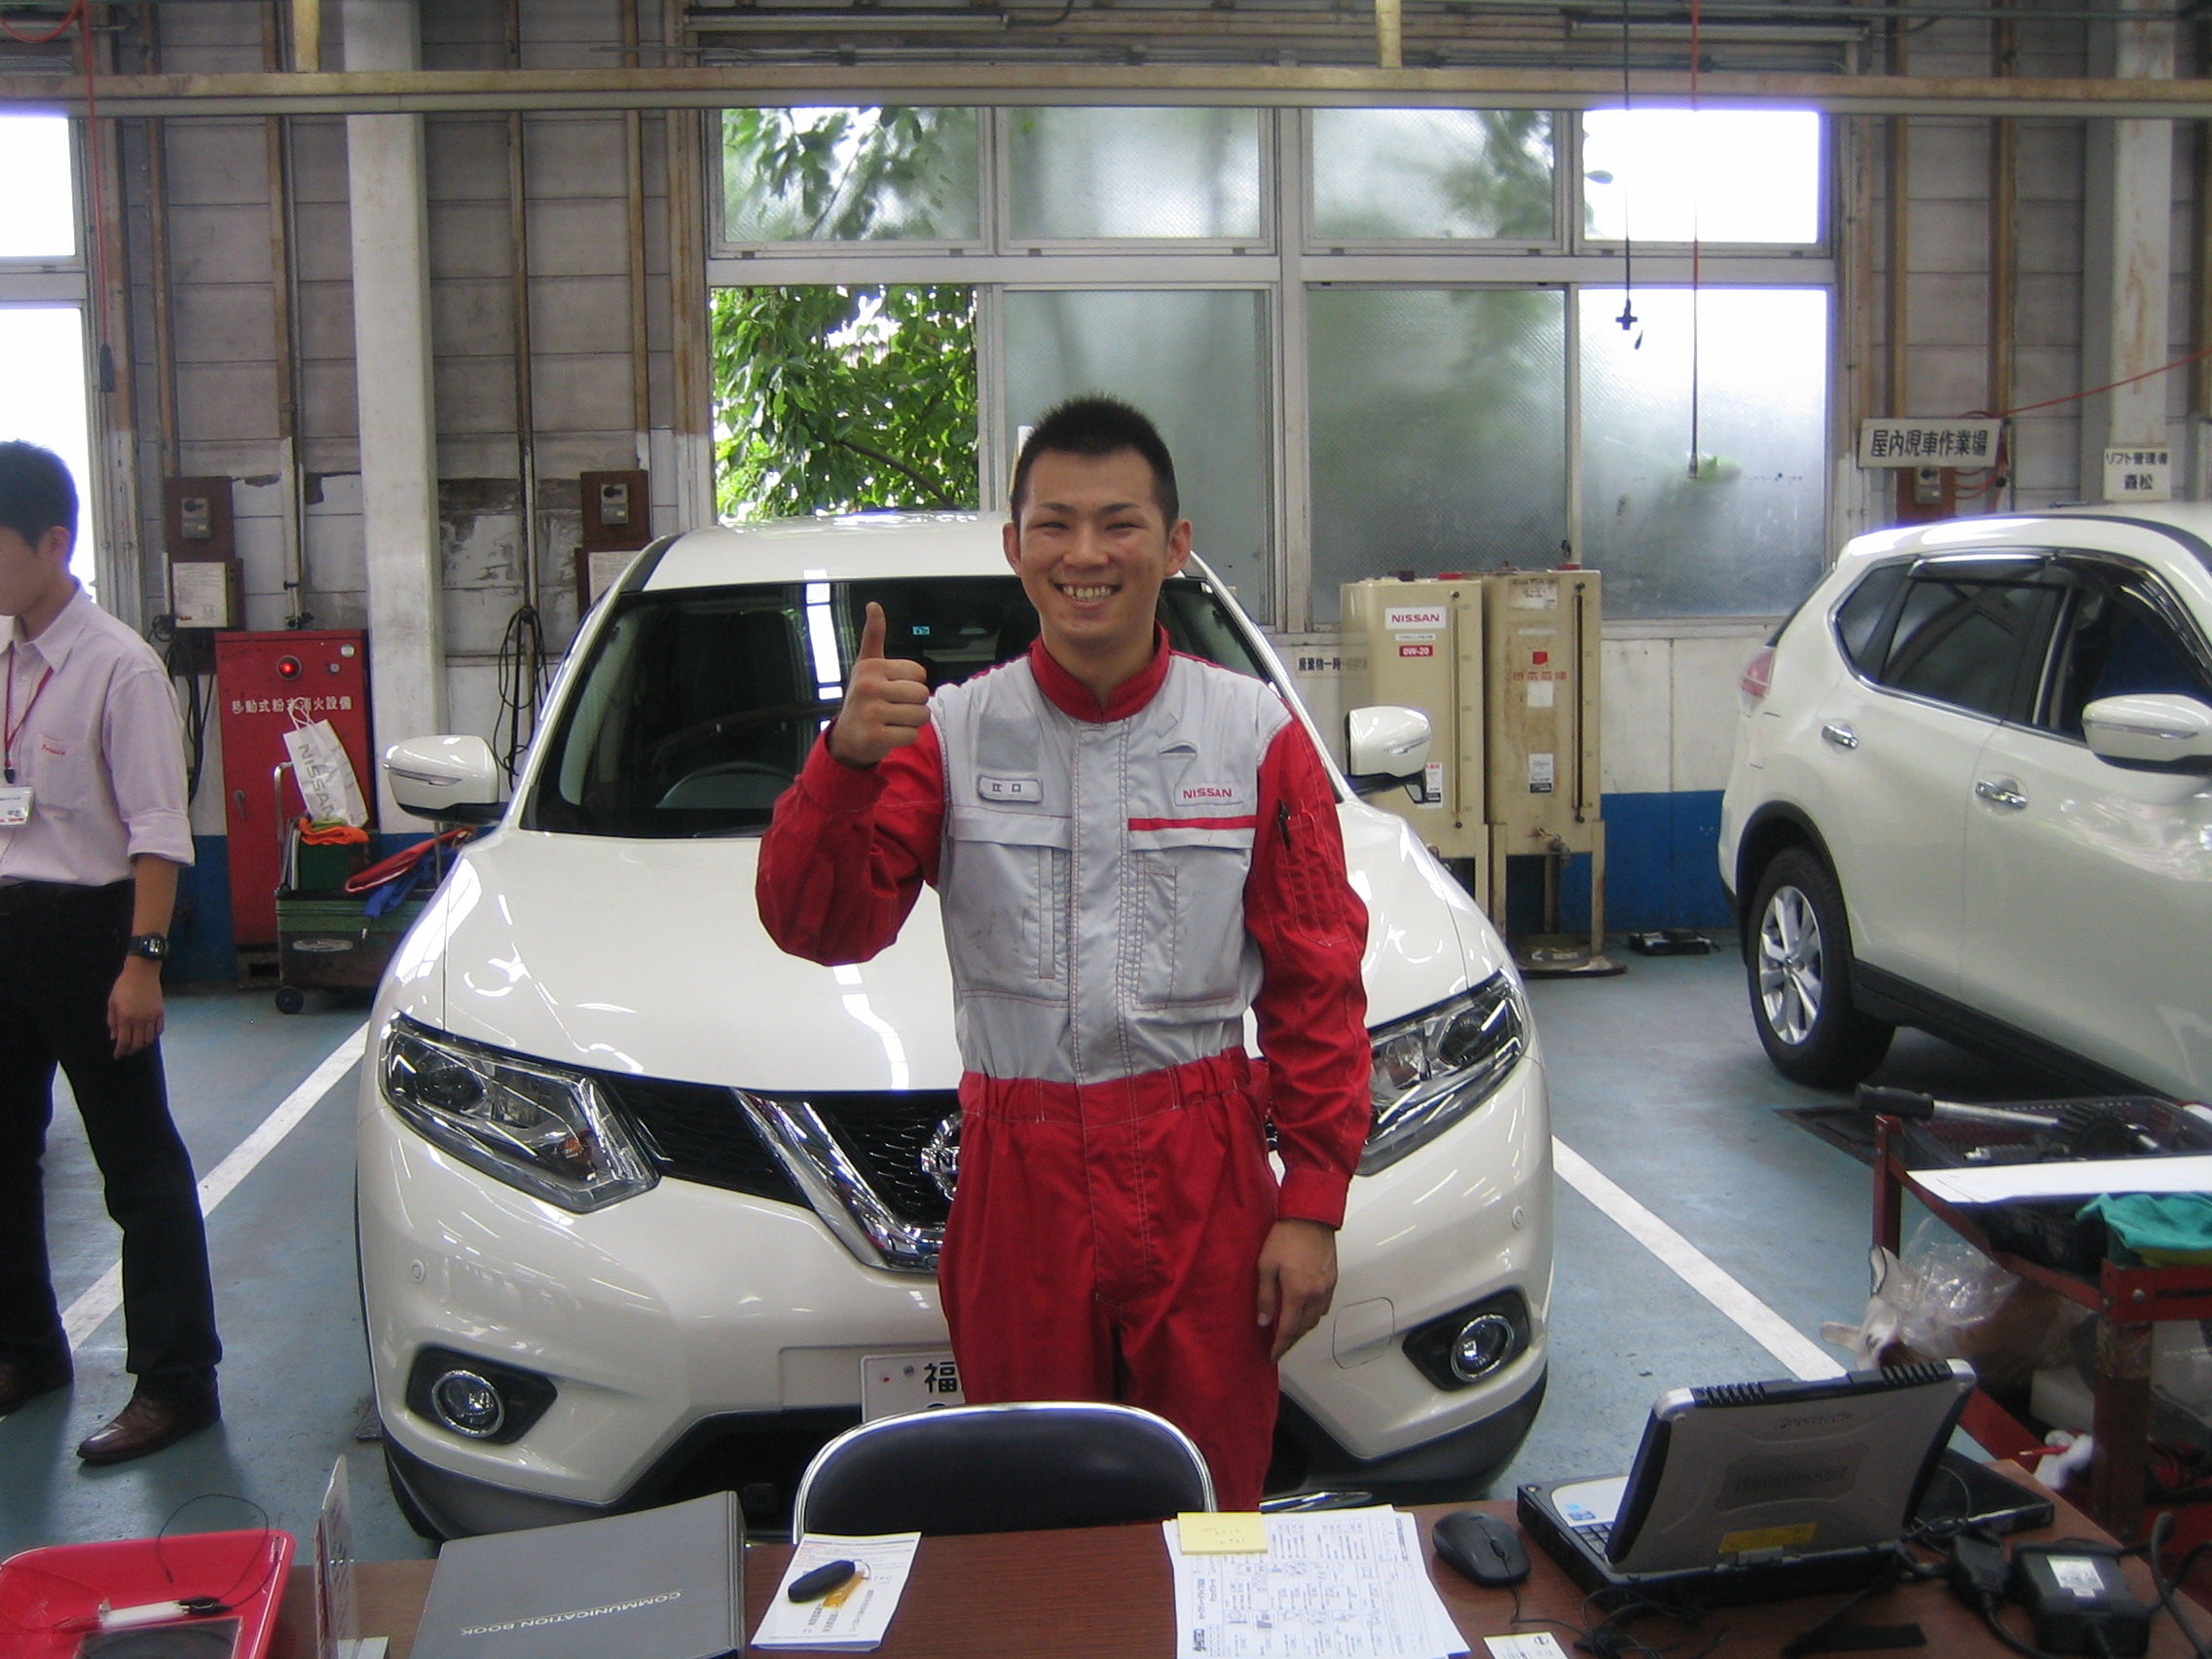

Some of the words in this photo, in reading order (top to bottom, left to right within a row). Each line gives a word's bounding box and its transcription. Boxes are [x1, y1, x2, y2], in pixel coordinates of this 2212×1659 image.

[1391, 612, 1440, 623] NISSAN
[1183, 788, 1233, 798] NISSAN
[520, 1590, 682, 1628] COMMUNICATION
[461, 1621, 515, 1637] BOOK
